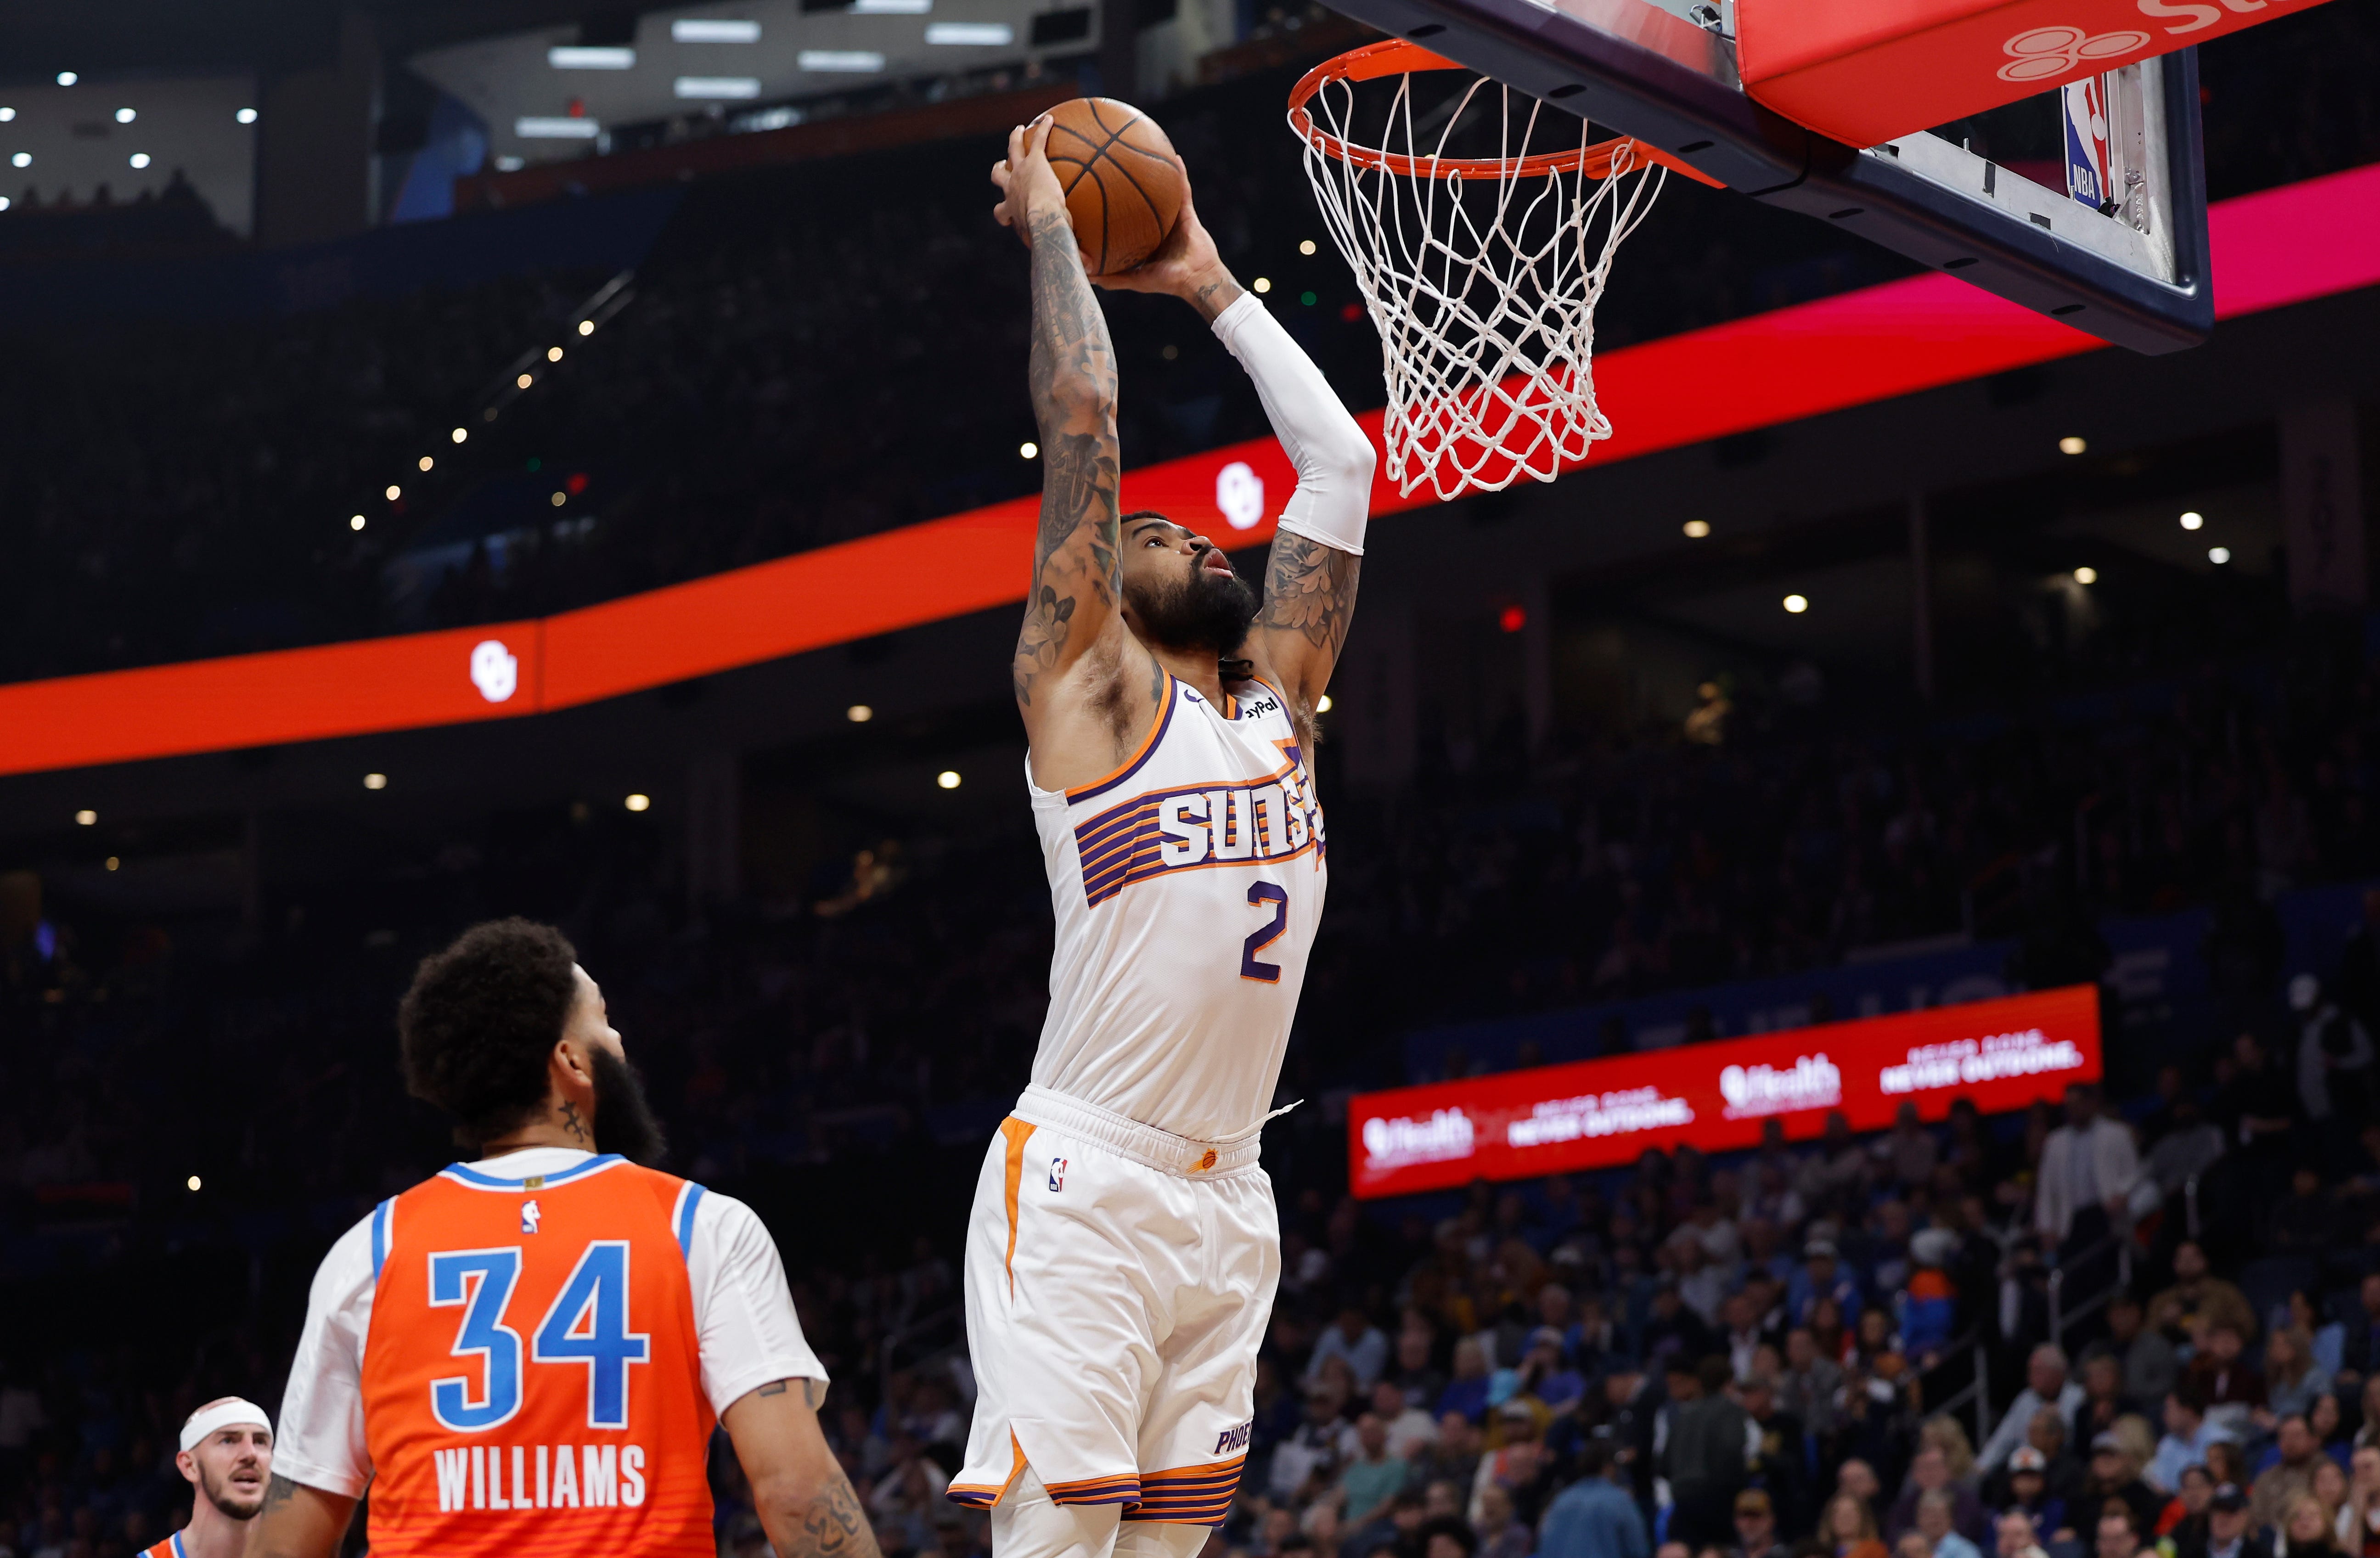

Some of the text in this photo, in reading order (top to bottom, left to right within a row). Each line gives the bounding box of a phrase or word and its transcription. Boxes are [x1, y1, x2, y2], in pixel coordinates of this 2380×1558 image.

[2073, 163, 2095, 200] NBA
[1245, 697, 1278, 719] ayPal
[1159, 776, 1310, 867] SUNS
[1240, 880, 1288, 984] 2
[428, 1239, 650, 1432] 34
[434, 1444, 645, 1512] WILLIAMS
